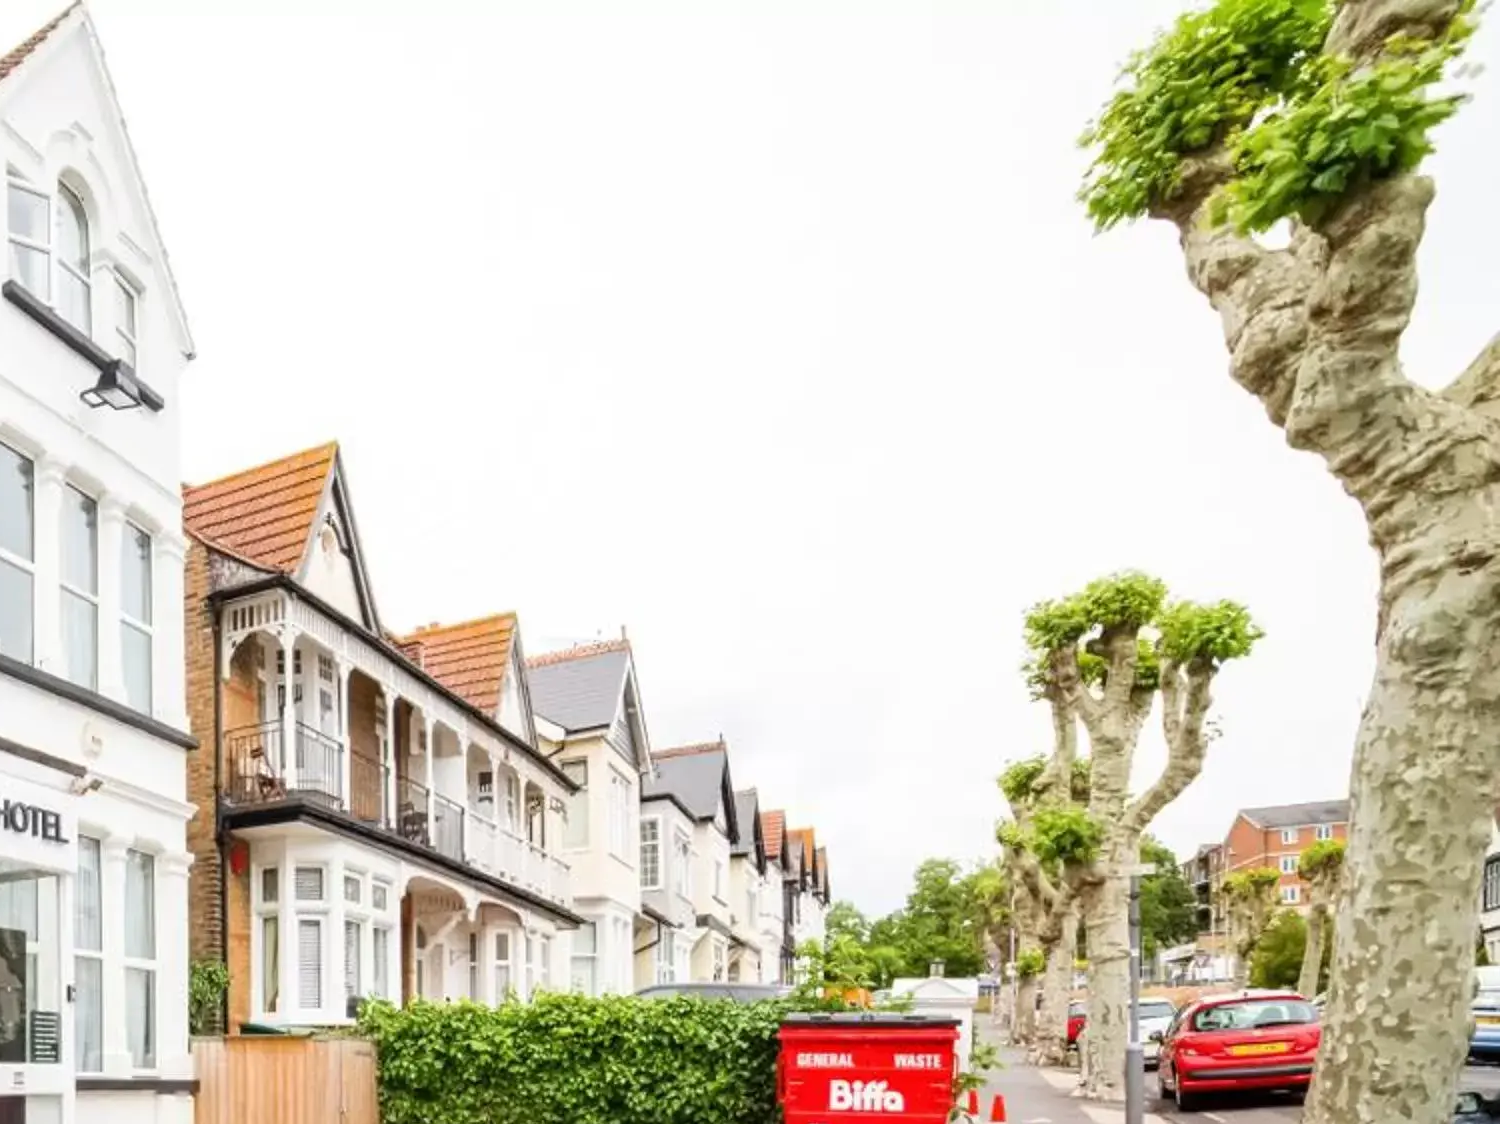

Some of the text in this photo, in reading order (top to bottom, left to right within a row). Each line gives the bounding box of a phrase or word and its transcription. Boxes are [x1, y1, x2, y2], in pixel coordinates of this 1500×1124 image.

[797, 1052, 942, 1069] GENERAL WASTE
[829, 1079, 905, 1112] Biffa
